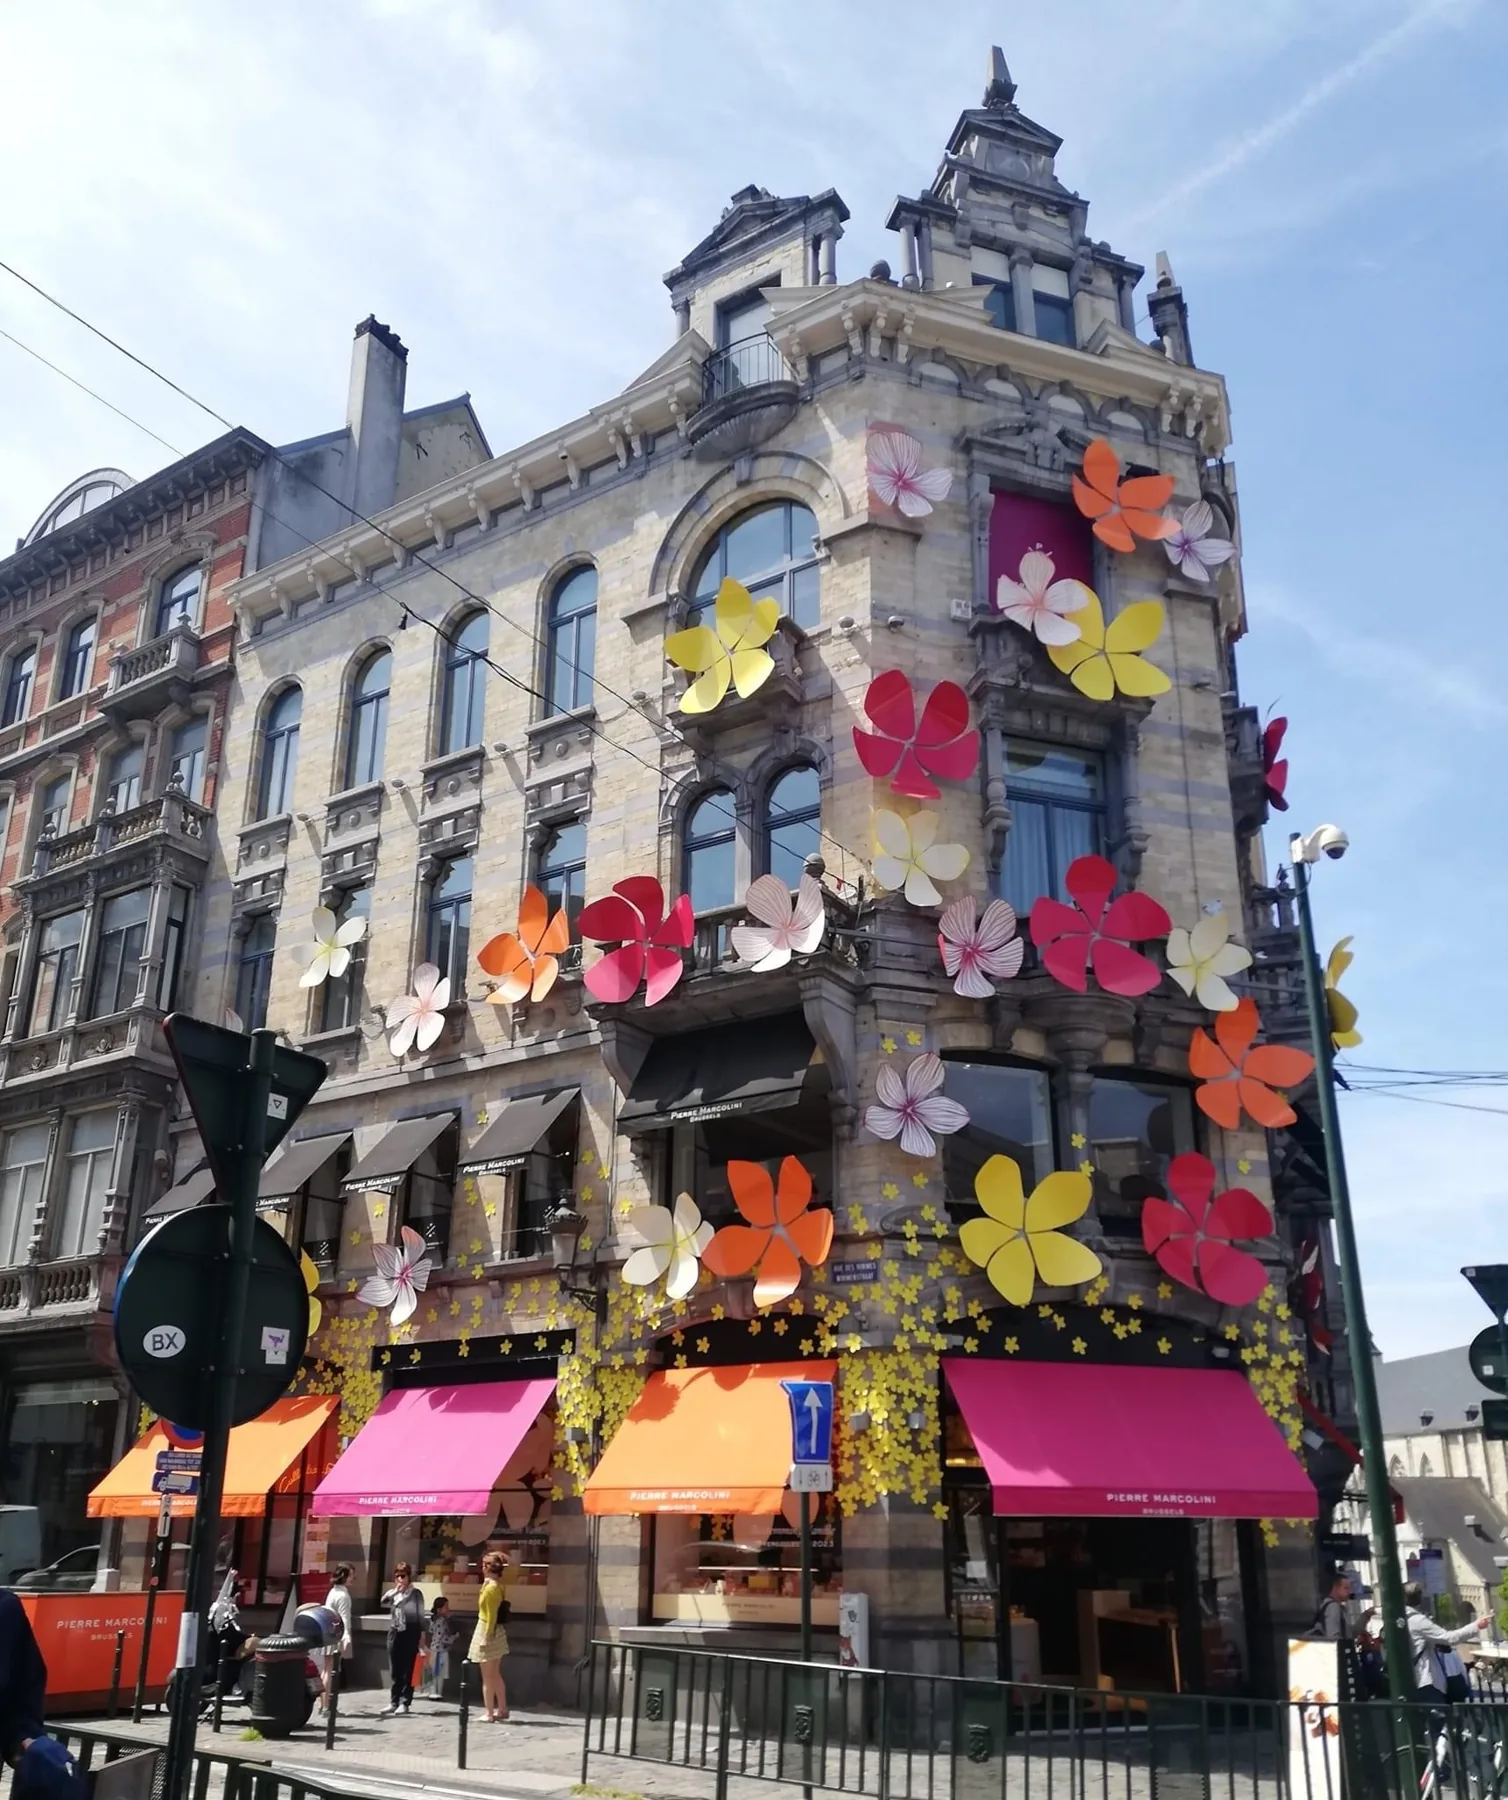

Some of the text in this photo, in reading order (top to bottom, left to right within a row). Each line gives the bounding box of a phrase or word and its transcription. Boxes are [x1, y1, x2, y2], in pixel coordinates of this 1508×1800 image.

[670, 1102, 743, 1120] PIERRE MARCOLINI
[152, 1332, 178, 1351] BX
[358, 1495, 437, 1505] PIERRE MARCOLINI
[630, 1490, 731, 1500] PIERRE MARCOLINI
[1106, 1493, 1217, 1504] PIERRE MARCOLINI
[57, 1617, 168, 1629] PIERRE MARCOINI
